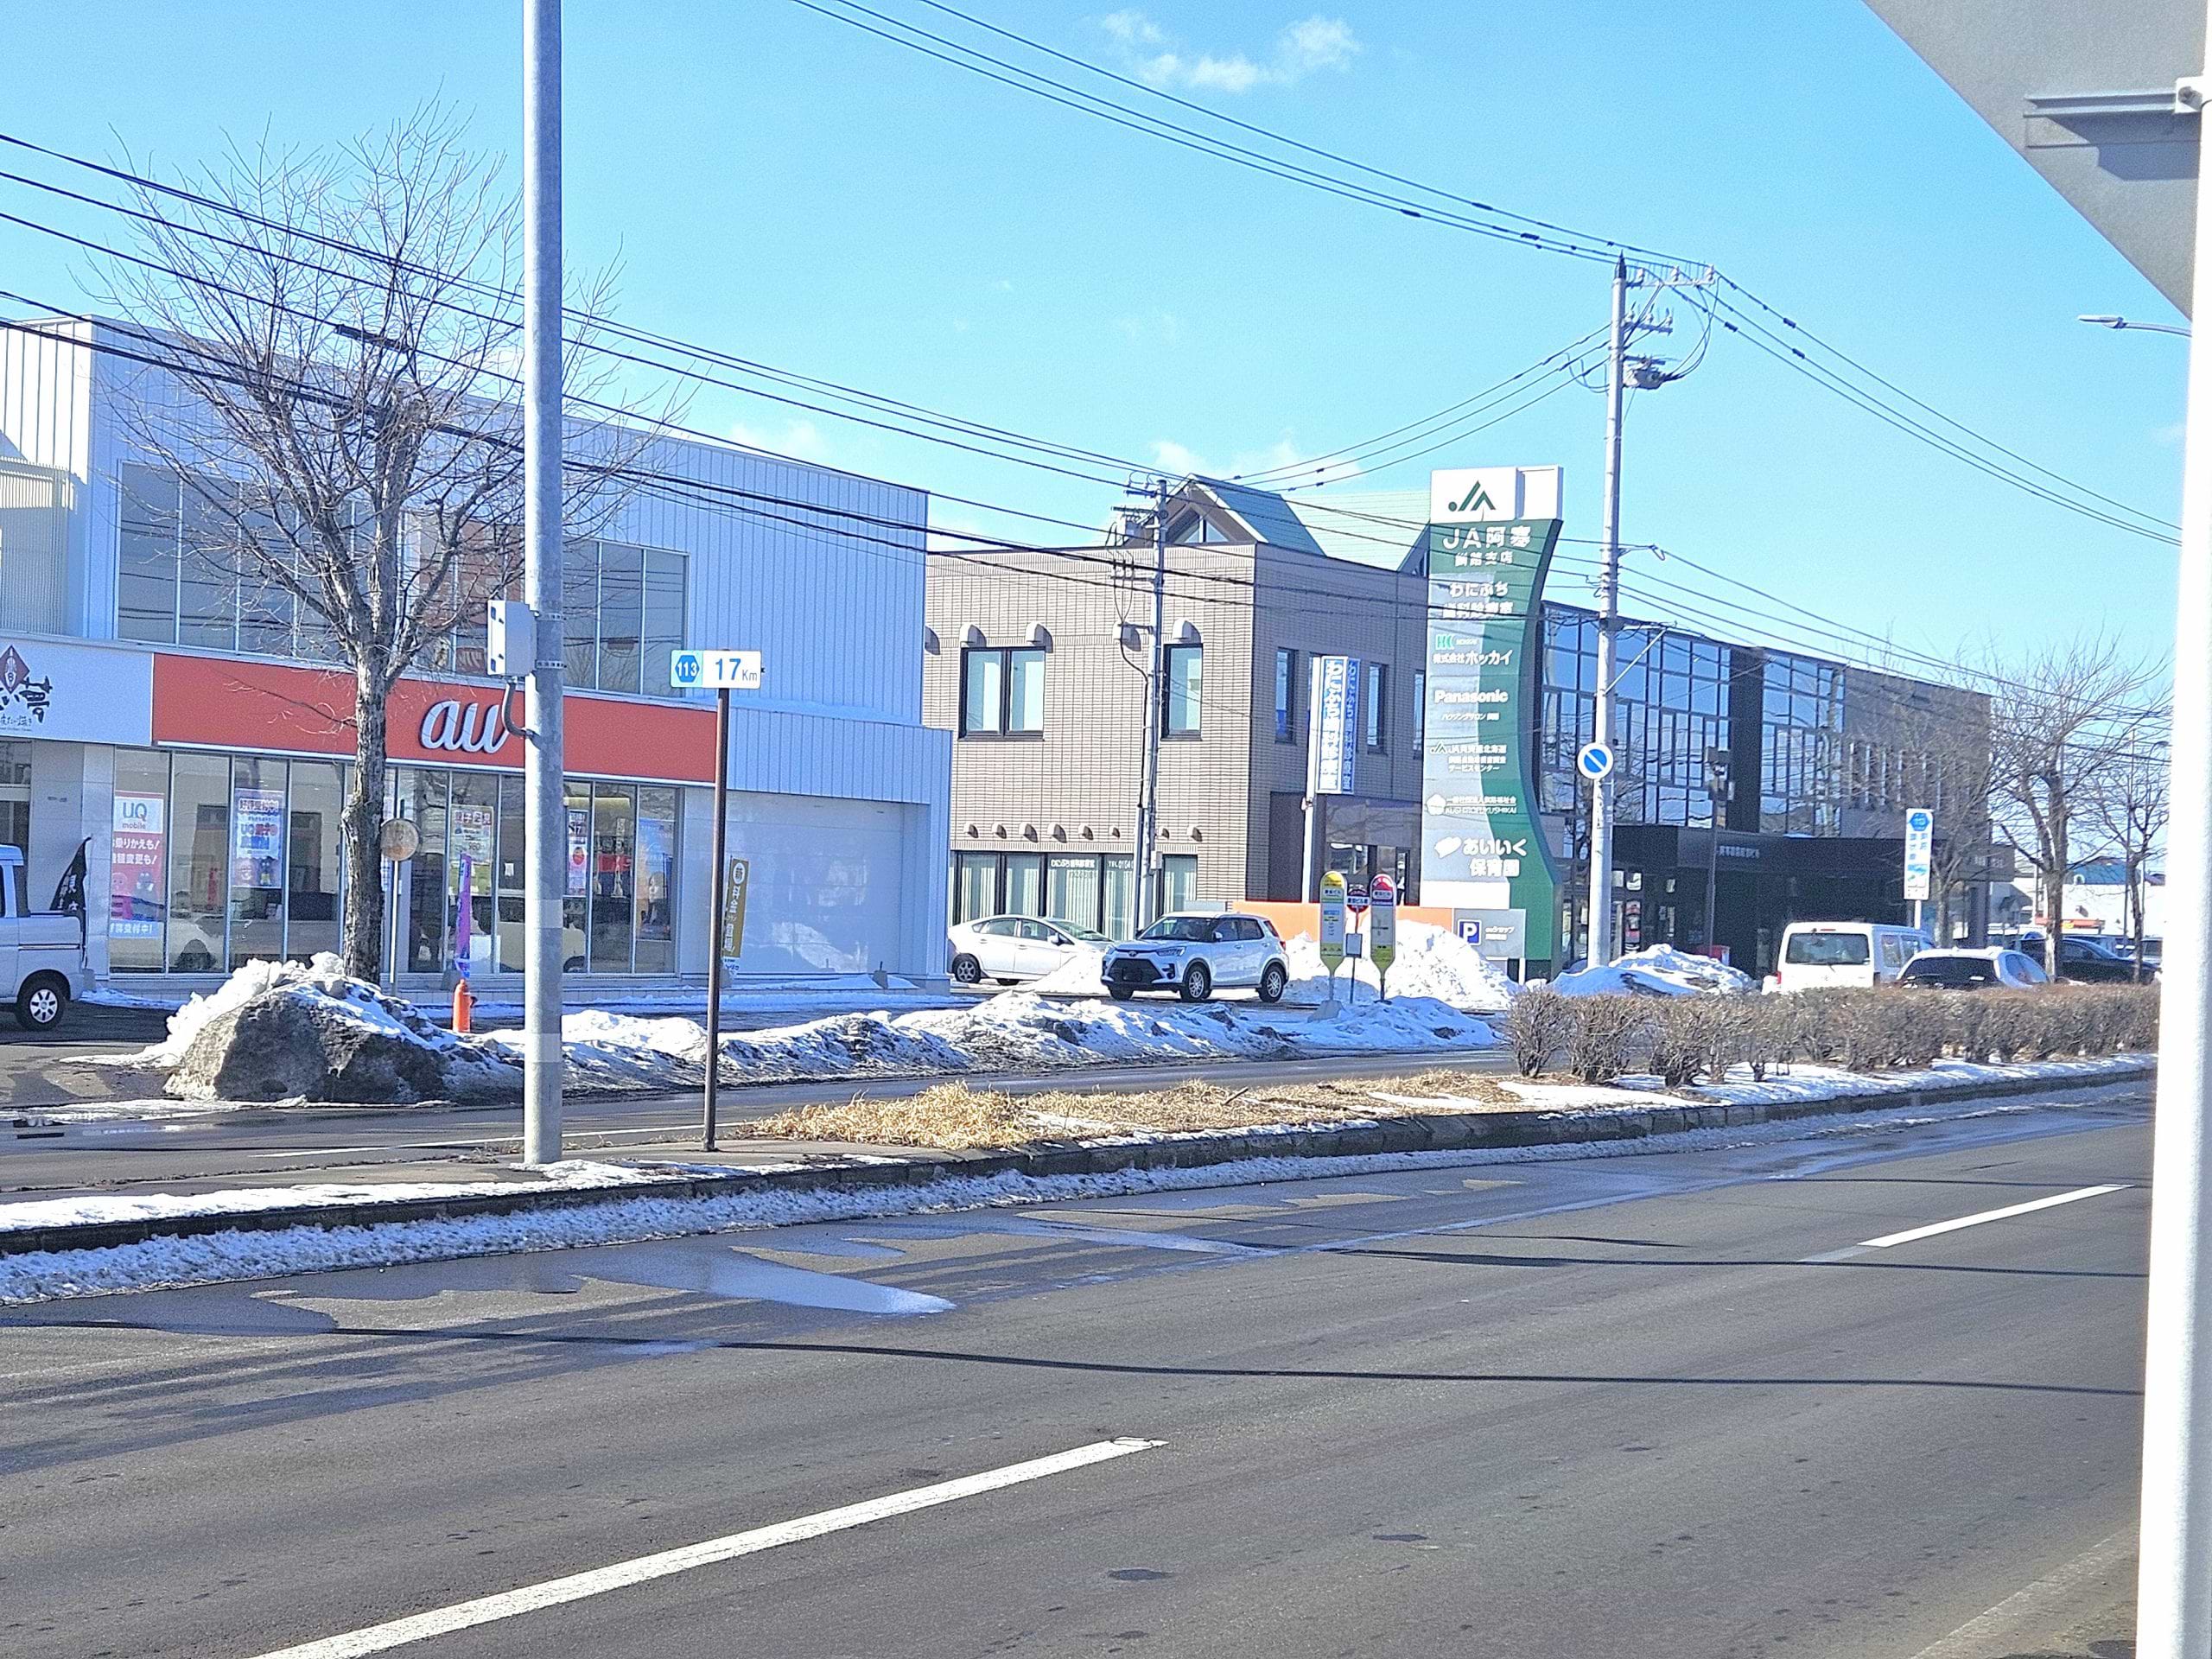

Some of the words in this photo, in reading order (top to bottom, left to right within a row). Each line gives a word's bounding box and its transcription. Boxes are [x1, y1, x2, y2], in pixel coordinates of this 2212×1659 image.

[1443, 525, 1531, 550] JA阿寒
[1450, 581, 1509, 598] わにぶち
[1433, 650, 1513, 665] 株式会社ホッカイ
[677, 662, 697, 677] 113
[1433, 689, 1509, 703] Panasonic
[421, 700, 510, 754] au
[123, 802, 147, 822] UQ
[1462, 837, 1527, 857] あいいく
[1469, 858, 1520, 877] 保育園
[1463, 923, 1478, 943] P
